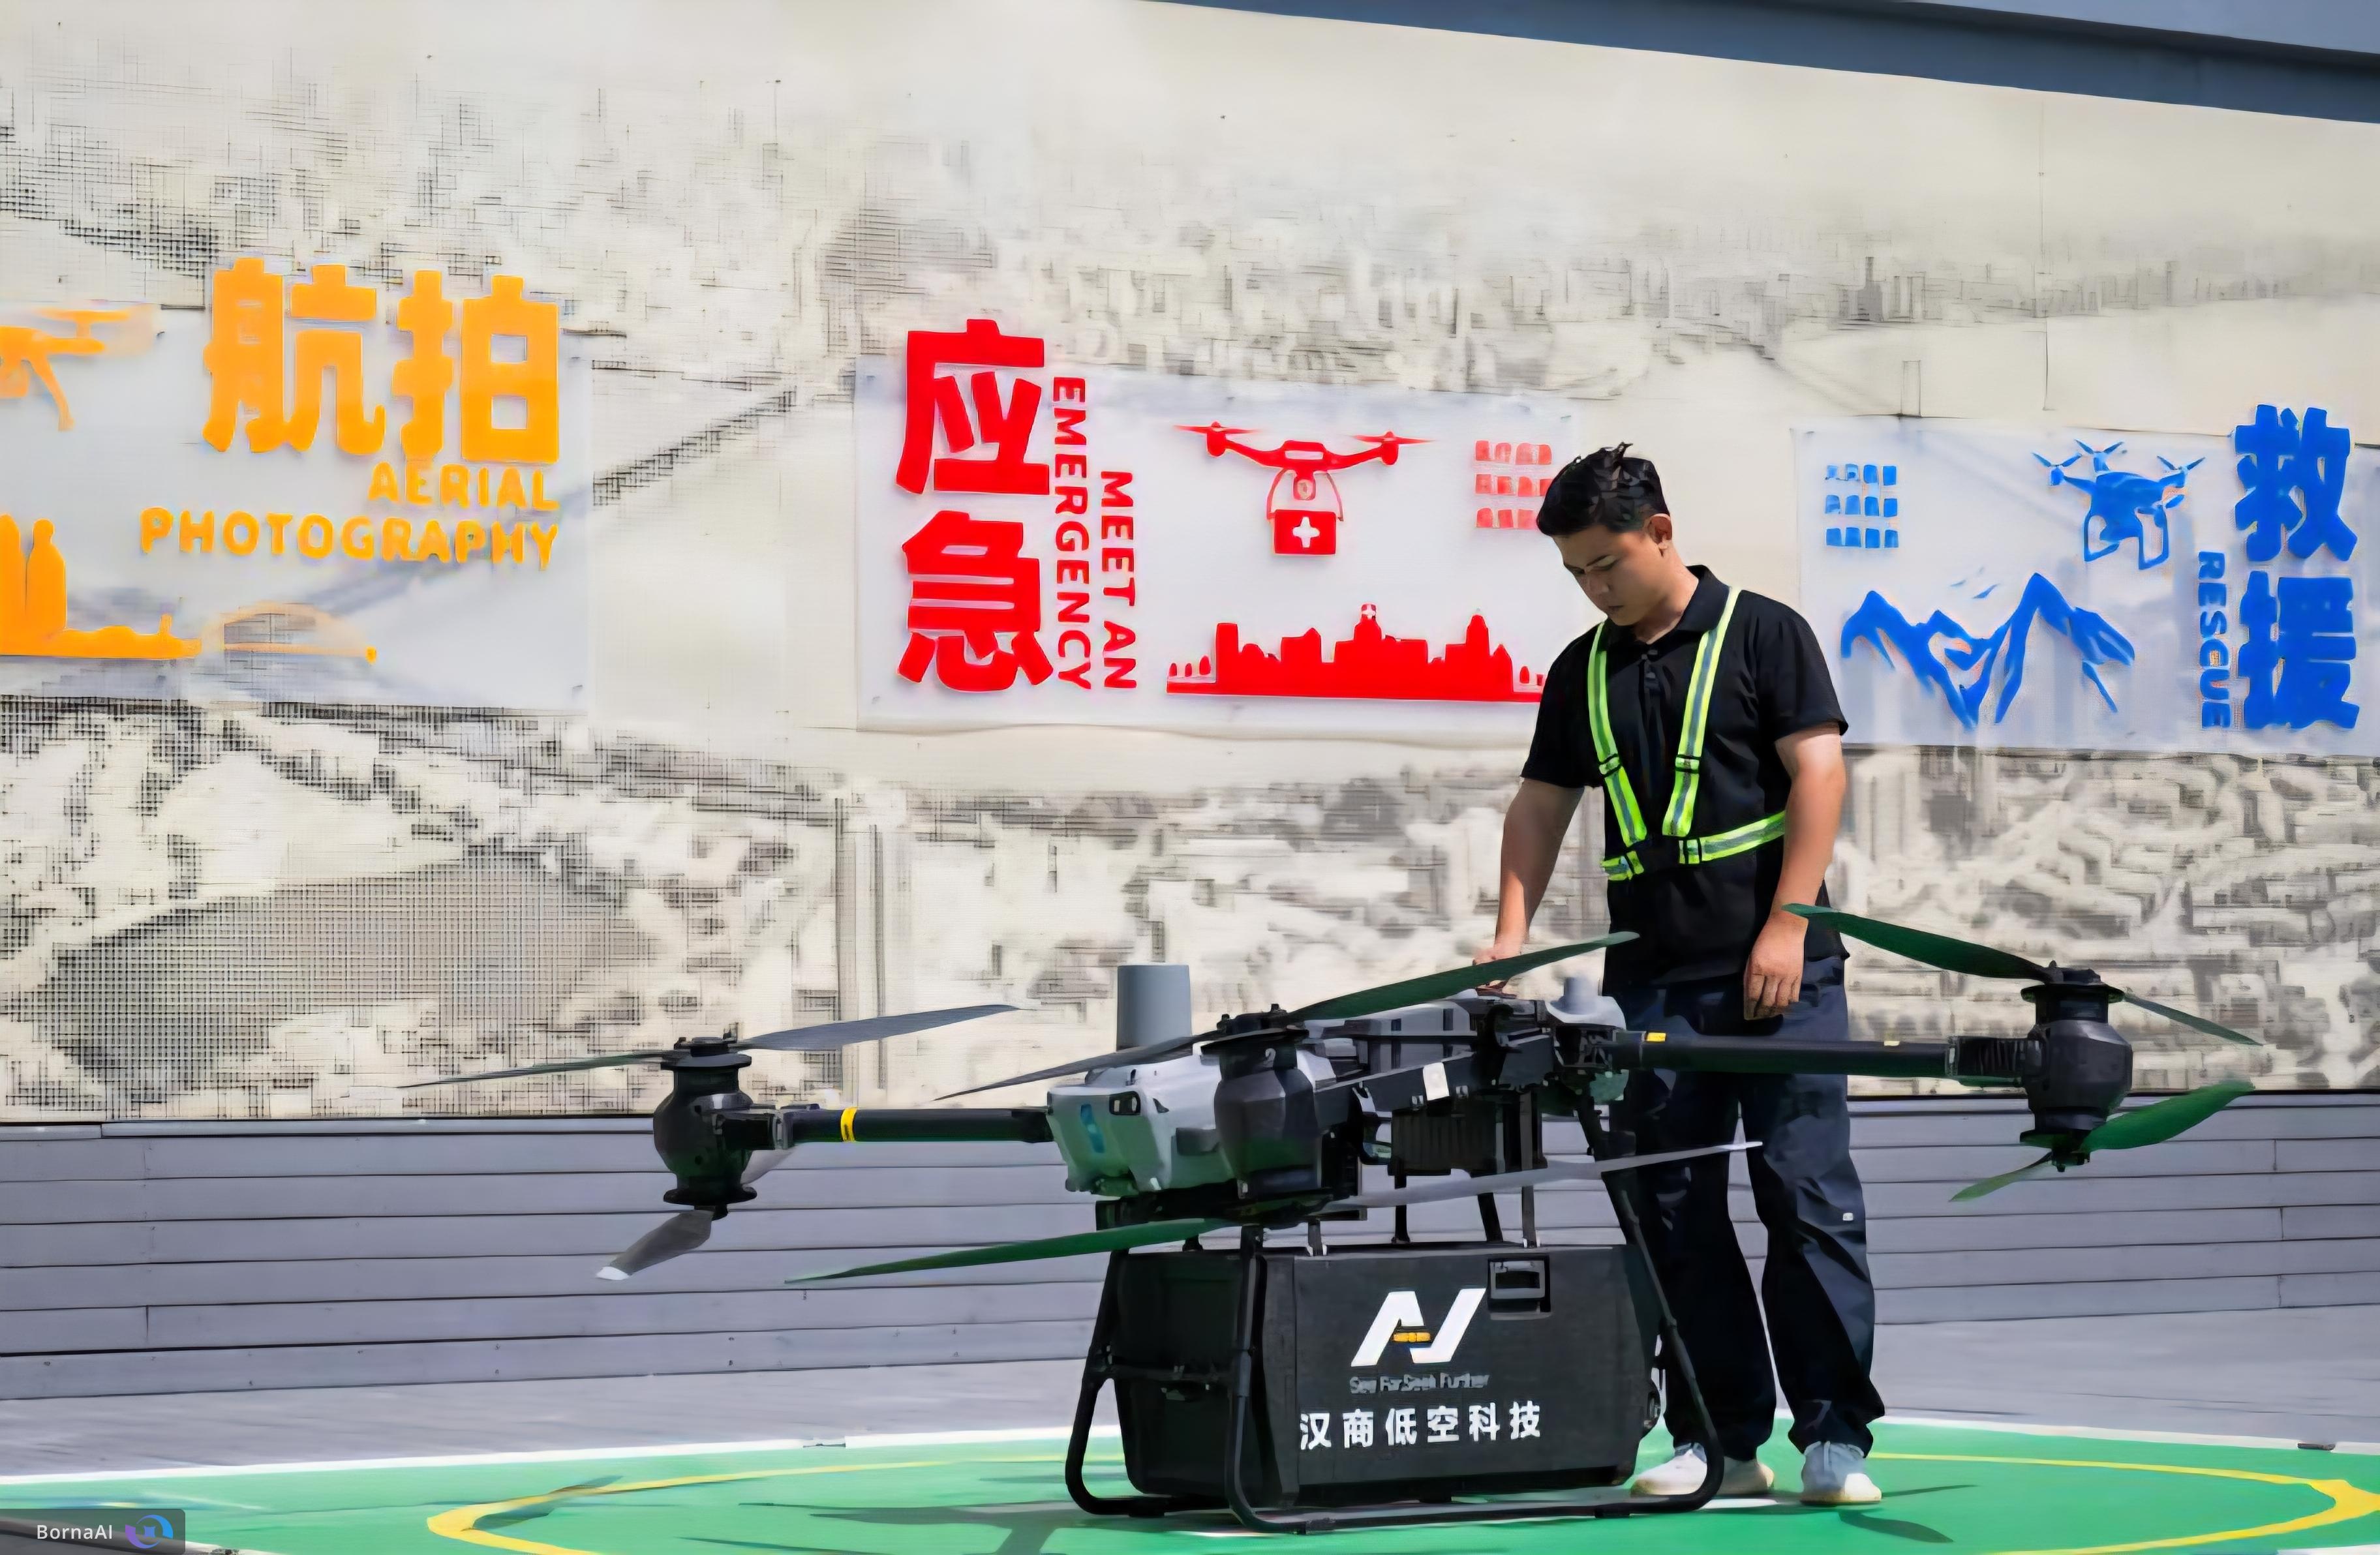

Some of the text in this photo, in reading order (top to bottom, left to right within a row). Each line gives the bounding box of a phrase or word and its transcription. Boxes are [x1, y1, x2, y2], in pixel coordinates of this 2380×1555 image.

[202, 258, 560, 464] 航拍
[140, 506, 560, 570] PHOTOGRAPHY
[368, 462, 560, 511] AERIAL
[895, 318, 1054, 693] 应急
[1052, 376, 1092, 690] EMERGENCY
[1100, 470, 1137, 689] MEET AN
[2234, 404, 2360, 731] 救援
[2197, 551, 2232, 729] RESCUE
[1299, 1400, 1542, 1451] 汉商低空科技
